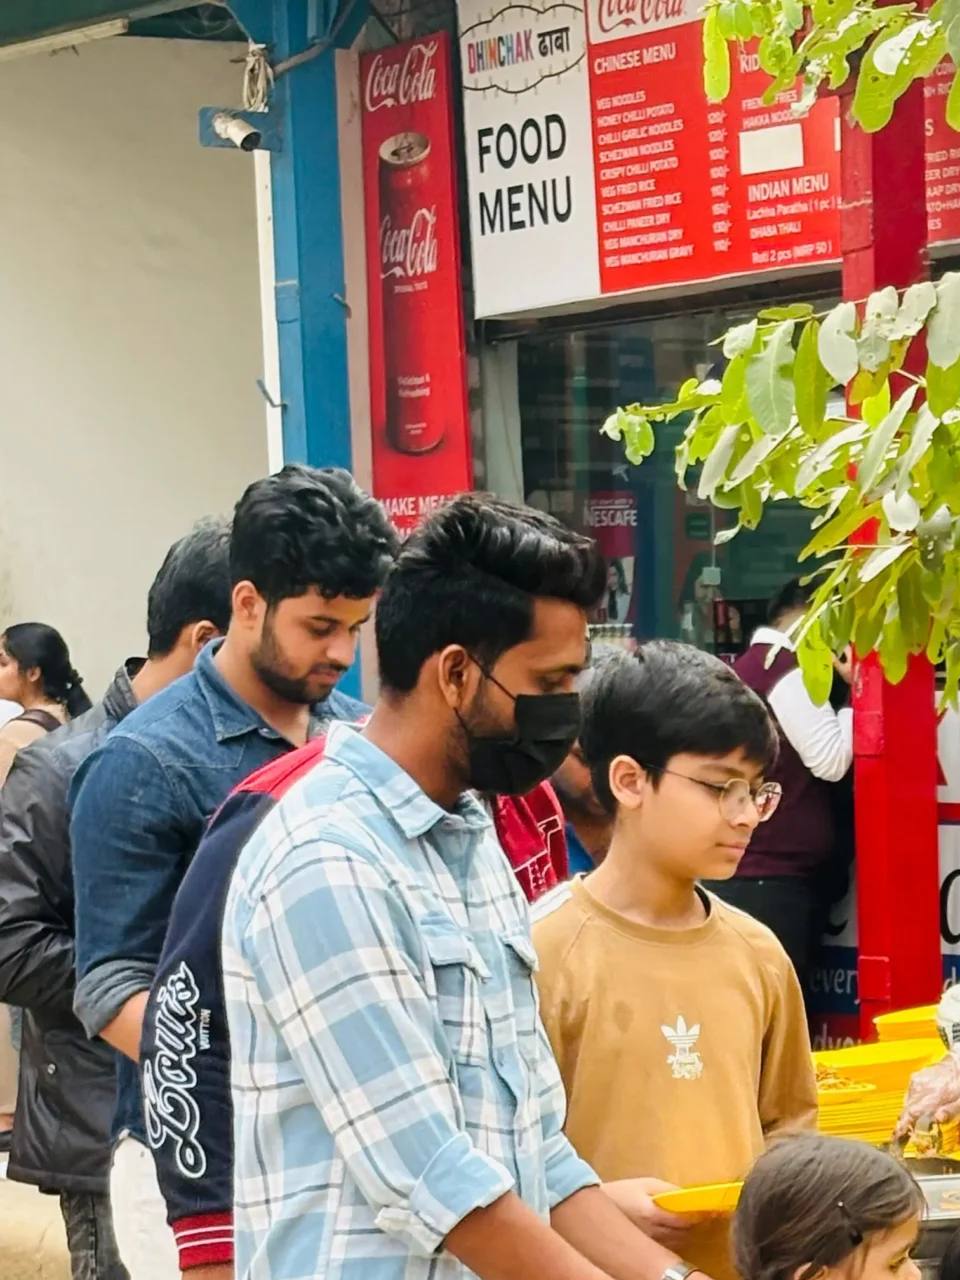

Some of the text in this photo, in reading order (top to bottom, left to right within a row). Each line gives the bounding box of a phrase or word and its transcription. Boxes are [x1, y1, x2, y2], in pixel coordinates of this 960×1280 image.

[468, 27, 570, 74] DHINCHAK ढाबा
[594, 42, 676, 74] CHINESE MENU
[740, 54, 760, 74] KID
[477, 113, 567, 173] FOOD
[748, 173, 829, 203] INDIAN MENU
[479, 176, 572, 236] MENU
[770, 249, 777, 262] 2
